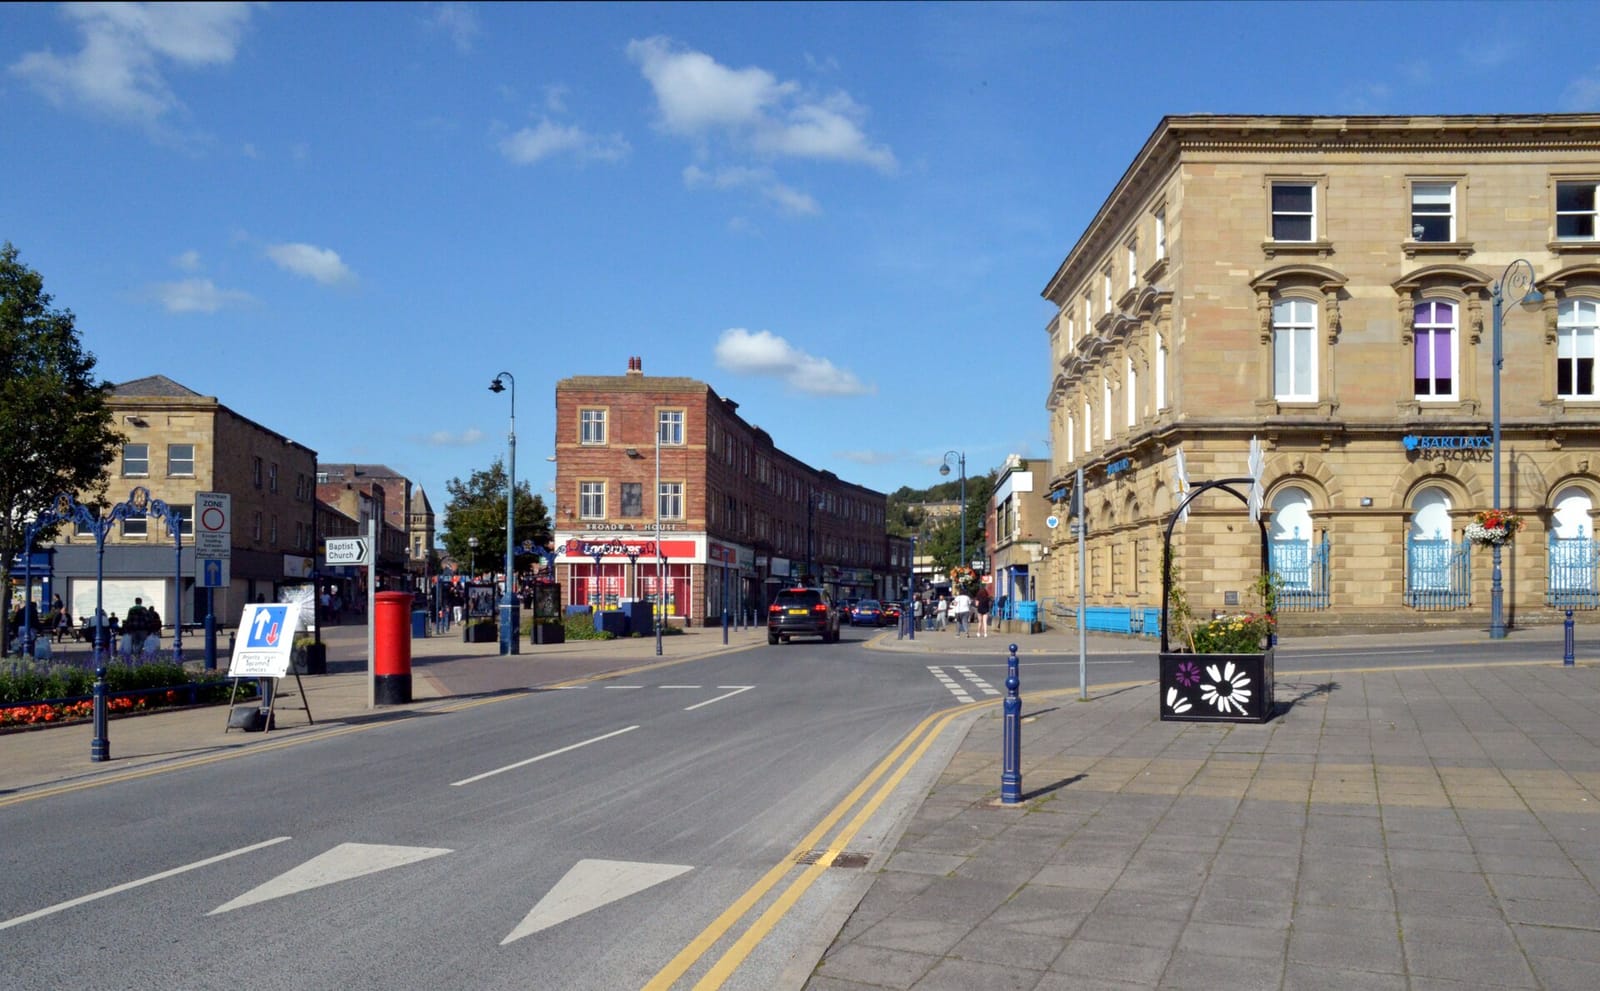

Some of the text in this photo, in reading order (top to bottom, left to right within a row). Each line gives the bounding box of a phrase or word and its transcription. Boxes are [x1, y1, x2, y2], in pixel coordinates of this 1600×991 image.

[1421, 436, 1492, 449] BARCLAYS
[203, 500, 225, 508] ZONE
[645, 523, 676, 531] HOUSE
[328, 543, 354, 552] Baptist
[328, 552, 354, 560] Church
